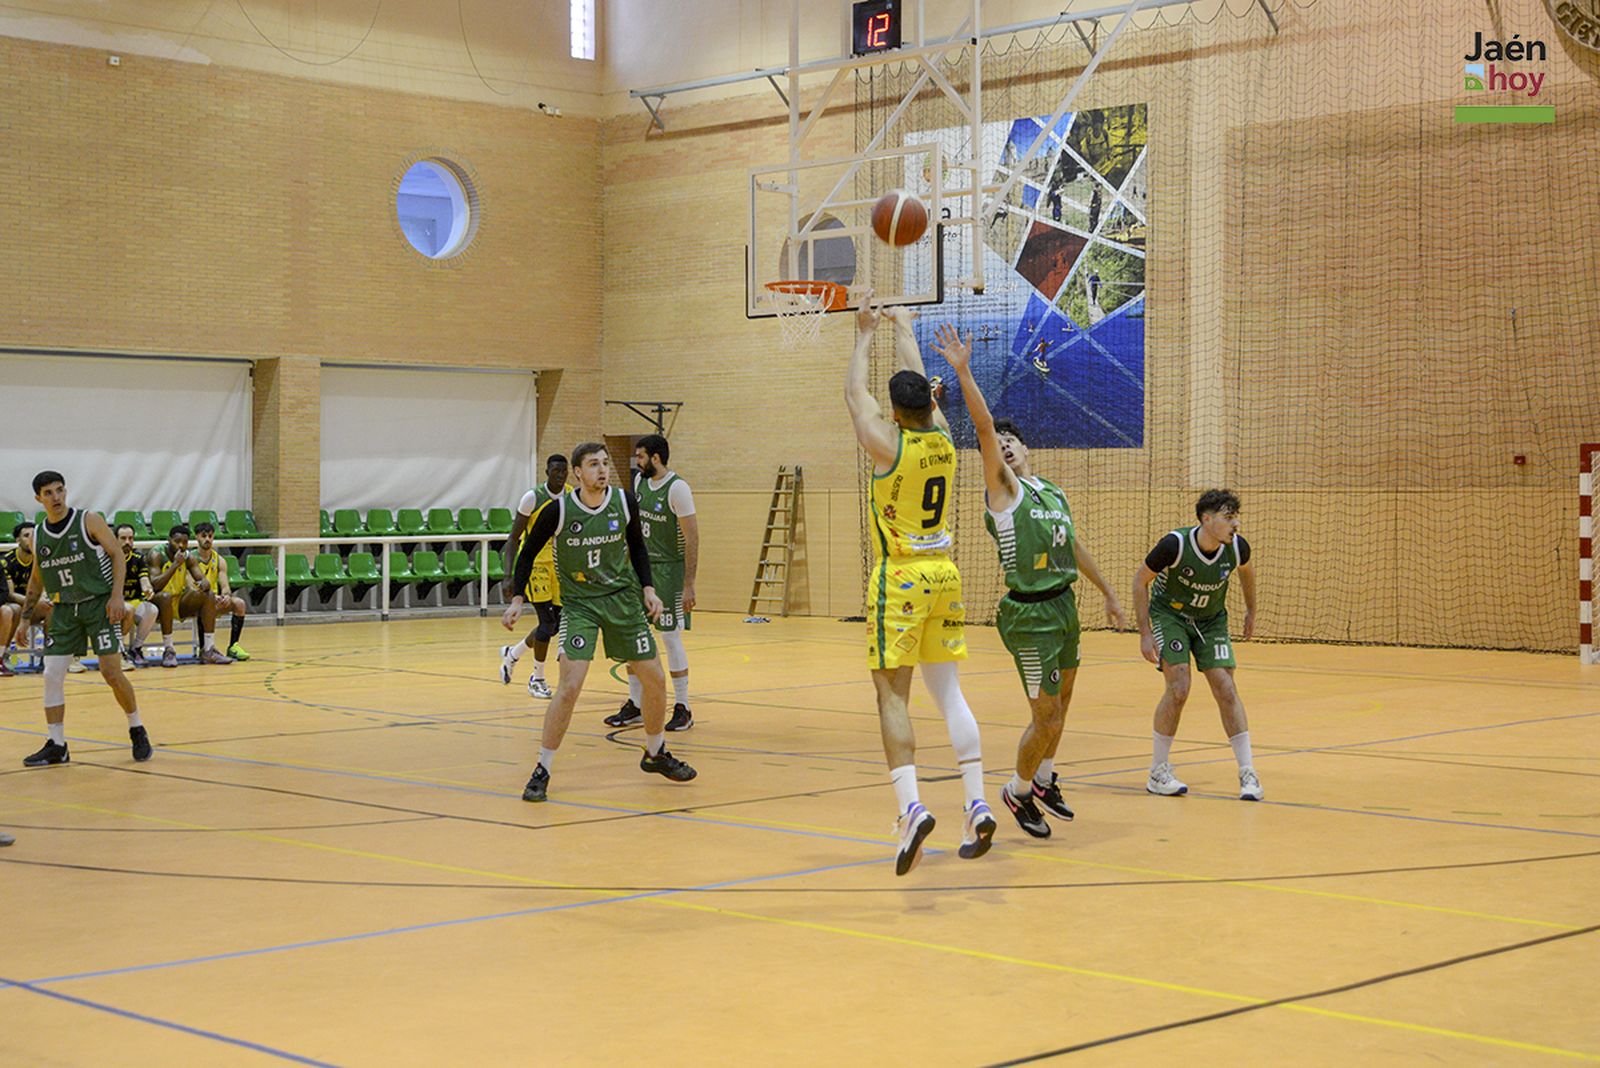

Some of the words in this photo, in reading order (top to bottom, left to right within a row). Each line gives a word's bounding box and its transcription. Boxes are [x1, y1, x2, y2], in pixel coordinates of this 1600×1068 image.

[867, 13, 889, 47] 12
[921, 475, 946, 529] 9
[641, 521, 651, 538] 8
[1052, 524, 1067, 548] 14
[566, 537, 581, 546] CB
[587, 549, 601, 569] 13
[58, 569, 74, 587] 15
[1191, 594, 1209, 608] 10
[660, 614, 673, 627] 88
[98, 635, 112, 650] 15
[636, 637, 650, 654] 13
[1214, 645, 1229, 660] 10
